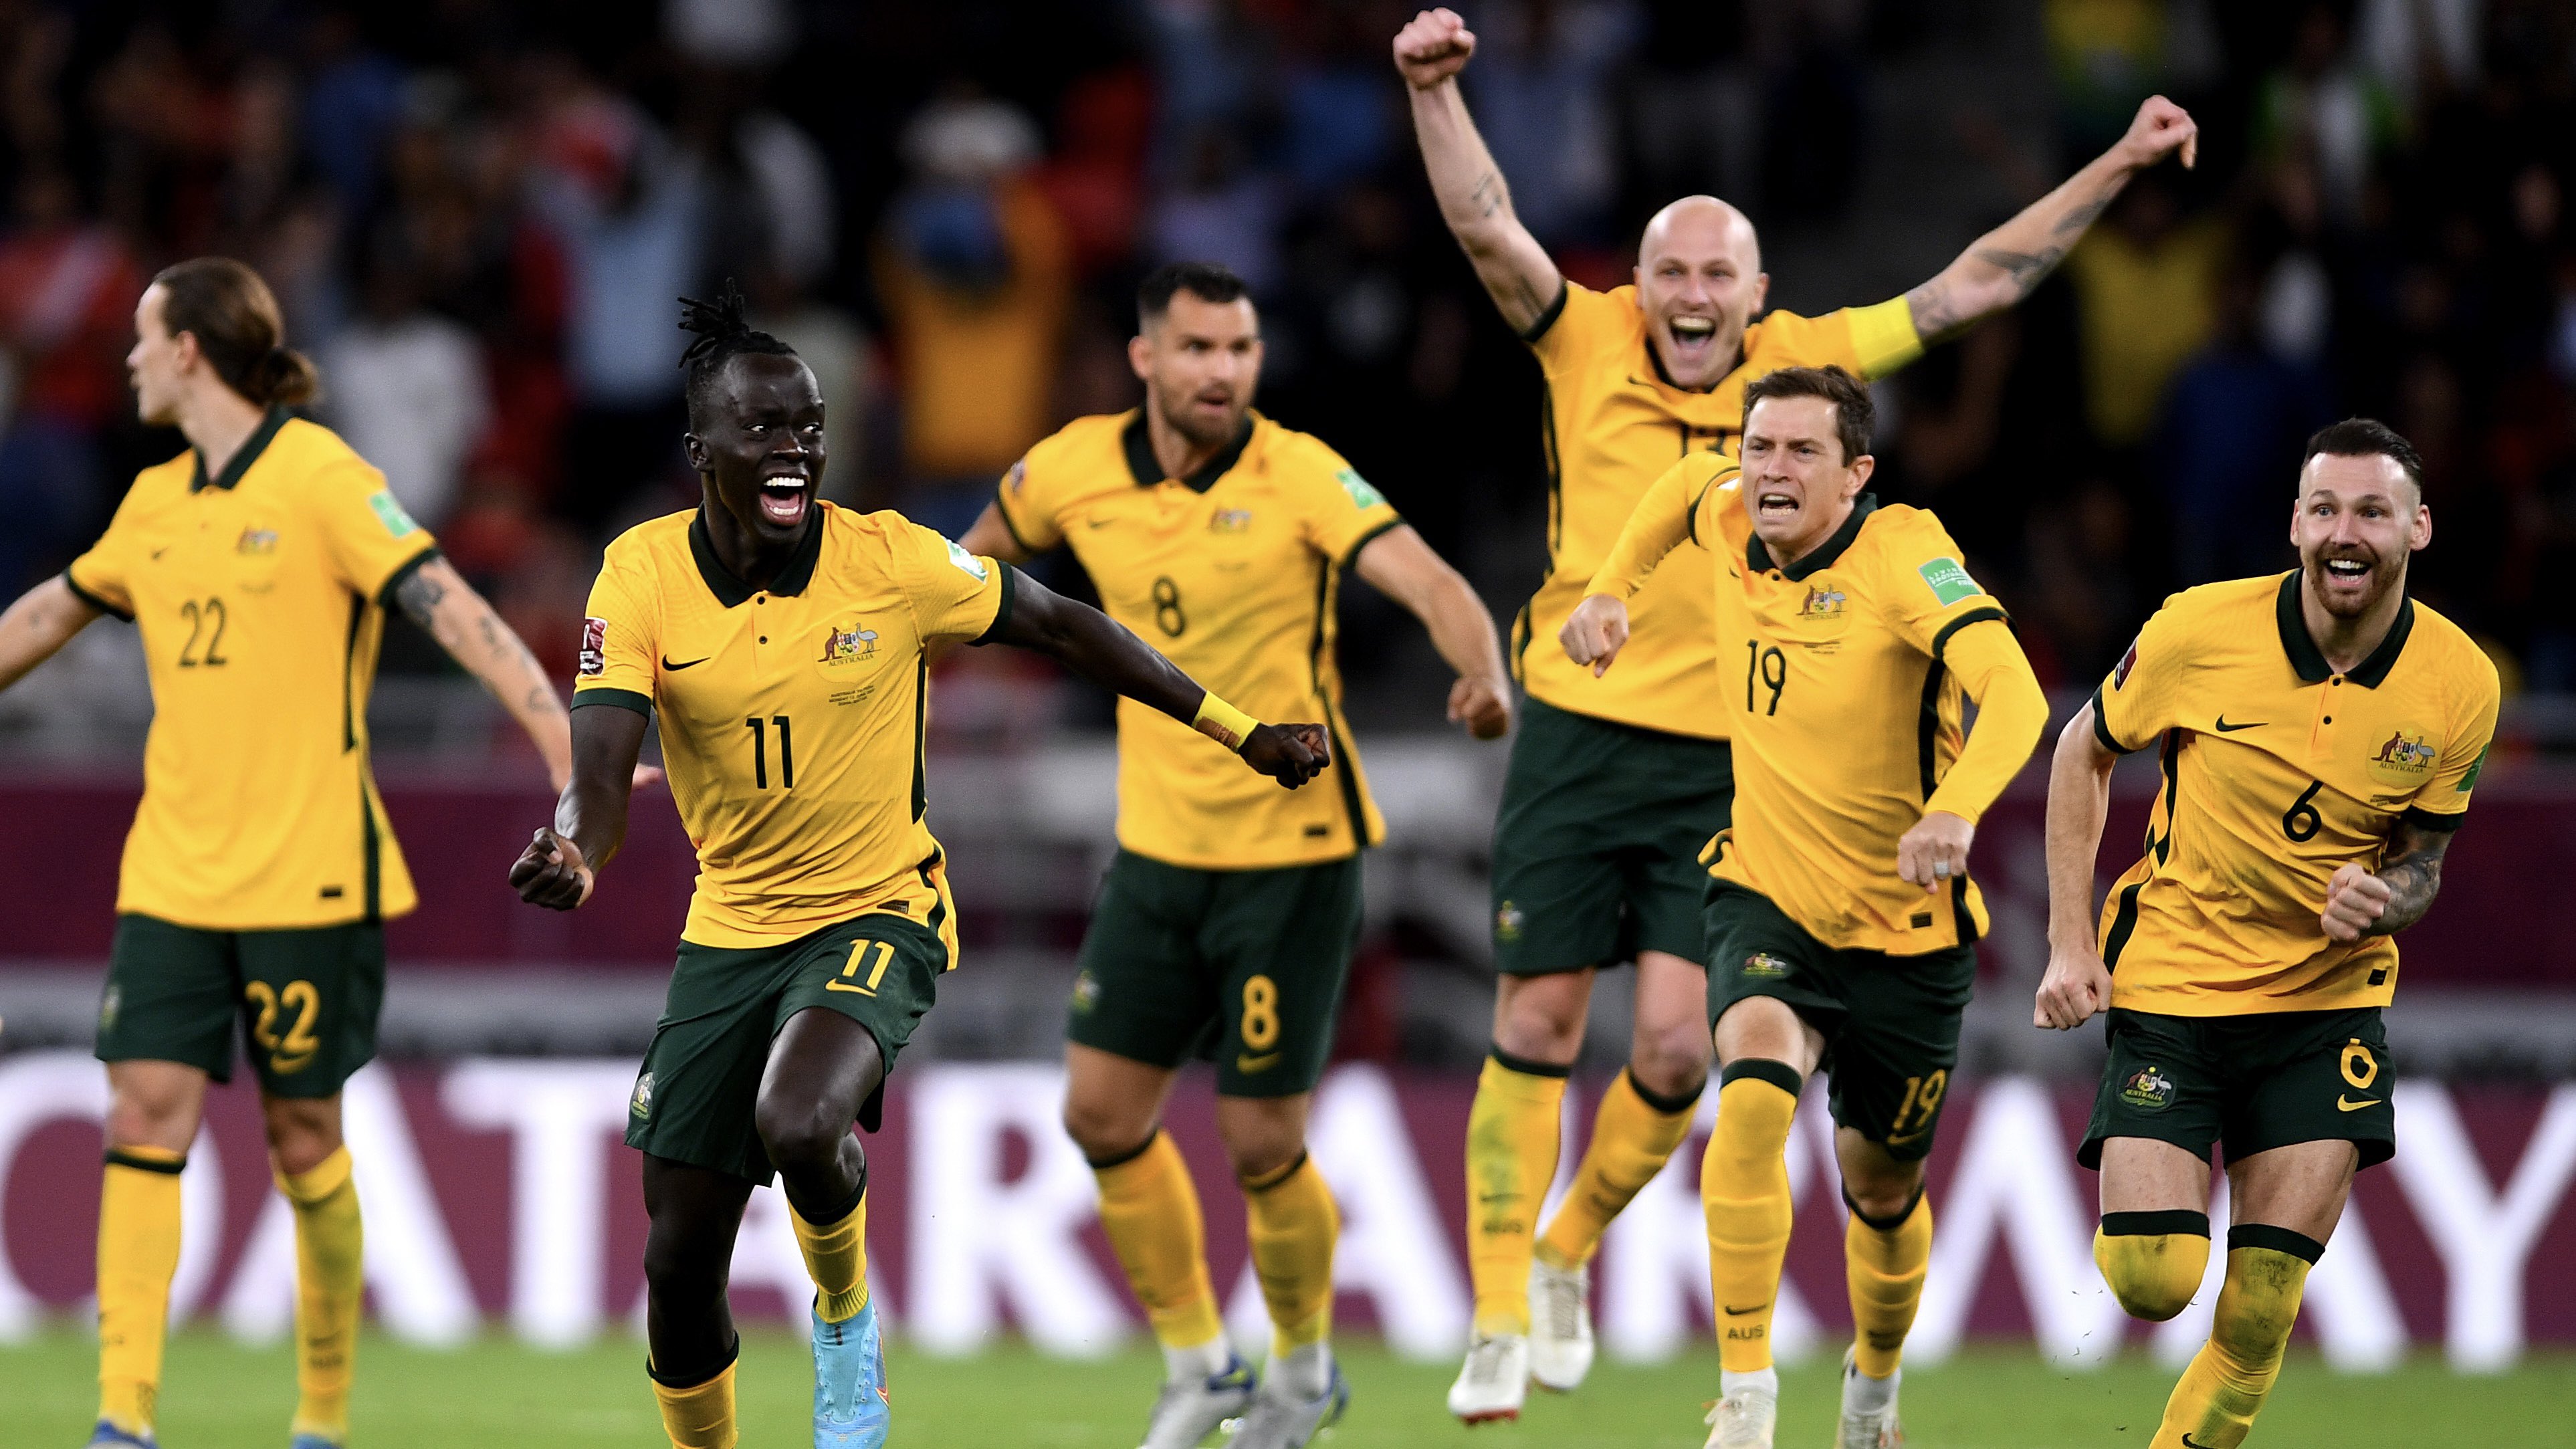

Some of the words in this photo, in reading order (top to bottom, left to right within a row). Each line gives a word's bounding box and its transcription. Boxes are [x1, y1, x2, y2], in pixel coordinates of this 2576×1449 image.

[178, 596, 228, 669] 22
[1151, 576, 1187, 638] 8
[829, 653, 874, 667] AUSTRALIA
[1746, 639, 1786, 716] 19
[745, 715, 793, 790] 11
[2379, 762, 2424, 774] AUSTRALIA
[2282, 779, 2323, 843] 6
[842, 939, 895, 990] 11
[245, 980, 320, 1054] 22
[1241, 975, 1279, 1050] 8
[1893, 1069, 1946, 1130] 19
[2125, 1089, 2163, 1102] AUSTRALIA
[1727, 1325, 1765, 1340] AUS
